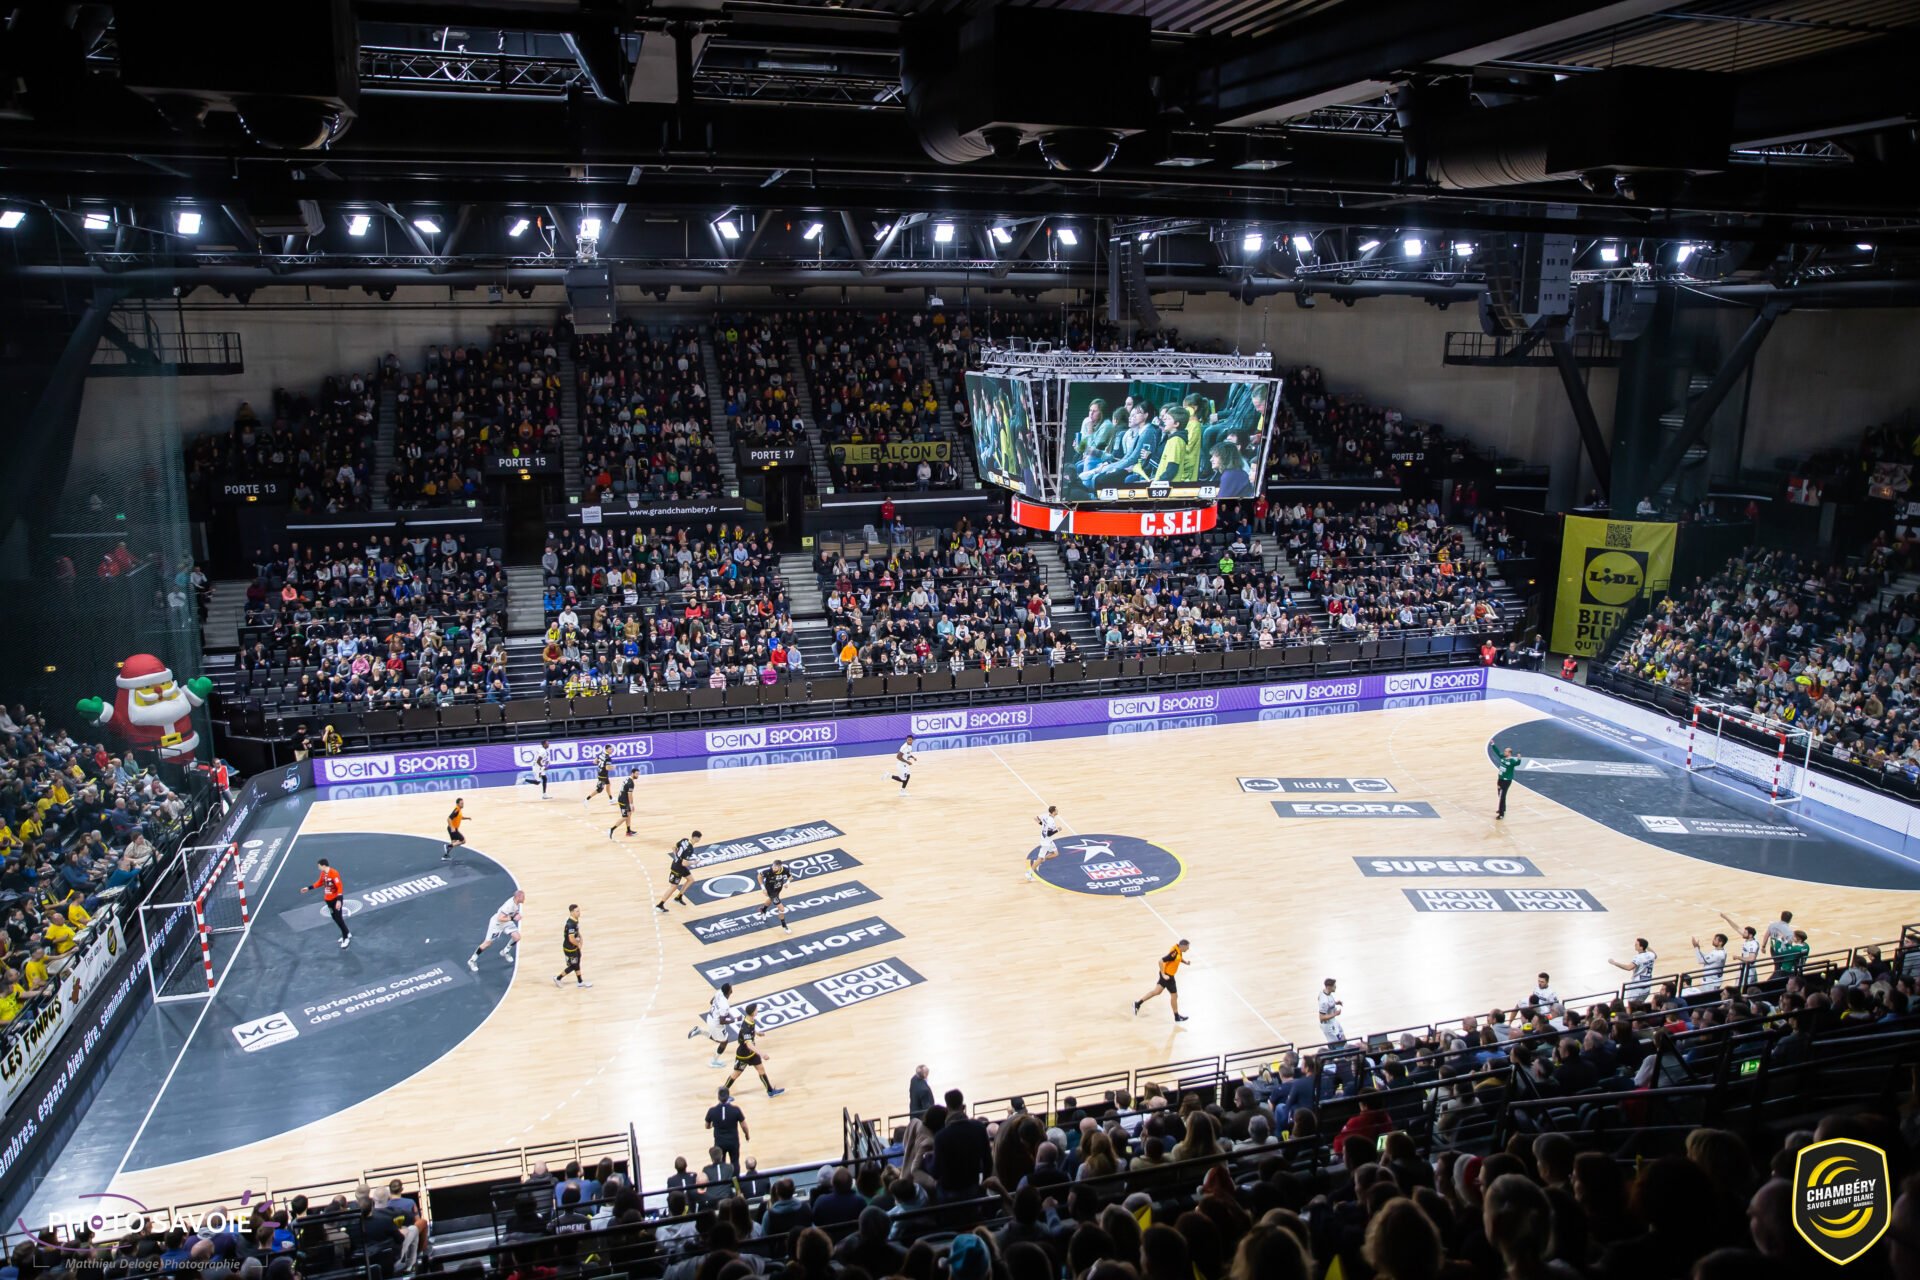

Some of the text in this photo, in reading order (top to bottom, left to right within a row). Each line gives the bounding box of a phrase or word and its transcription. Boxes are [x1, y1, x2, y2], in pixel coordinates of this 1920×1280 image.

[499, 457, 546, 468] PORTE 15
[751, 450, 795, 460] PORTE 17
[1392, 452, 1425, 461] PORTE 23
[224, 483, 277, 495] PORTE 13
[629, 504, 718, 517] www.grandchambery.fr
[1577, 624, 1609, 641] PLU
[1432, 672, 1479, 688] SPORTS
[1309, 682, 1356, 698] SPORTS
[1162, 695, 1214, 711] SPORTS
[970, 710, 1026, 727] SPORTS
[769, 726, 831, 744] SPORTS
[399, 754, 470, 774] SPORTS
[1293, 781, 1341, 790] lidl.fr
[1291, 803, 1419, 813] ECORA
[1085, 860, 1132, 872] LIQUI
[1090, 867, 1137, 880] MOLY
[1370, 860, 1486, 873] SUPER
[362, 874, 448, 907] SOFINTHER
[1423, 890, 1576, 900] LIQUI LIQUI
[1432, 901, 1585, 910] MOLY MOLY
[703, 920, 765, 939] CONSTRUCTION
[819, 963, 892, 992] LIQUI
[304, 967, 444, 1016] Partenaire conseil
[831, 975, 901, 1004] MOLY
[310, 975, 452, 1025] des entrepreneurs
[238, 1019, 288, 1039] MG
[1, 1044, 23, 1082] LES
[23, 995, 62, 1050] FONDUS
[67, 1045, 85, 1082] bien
